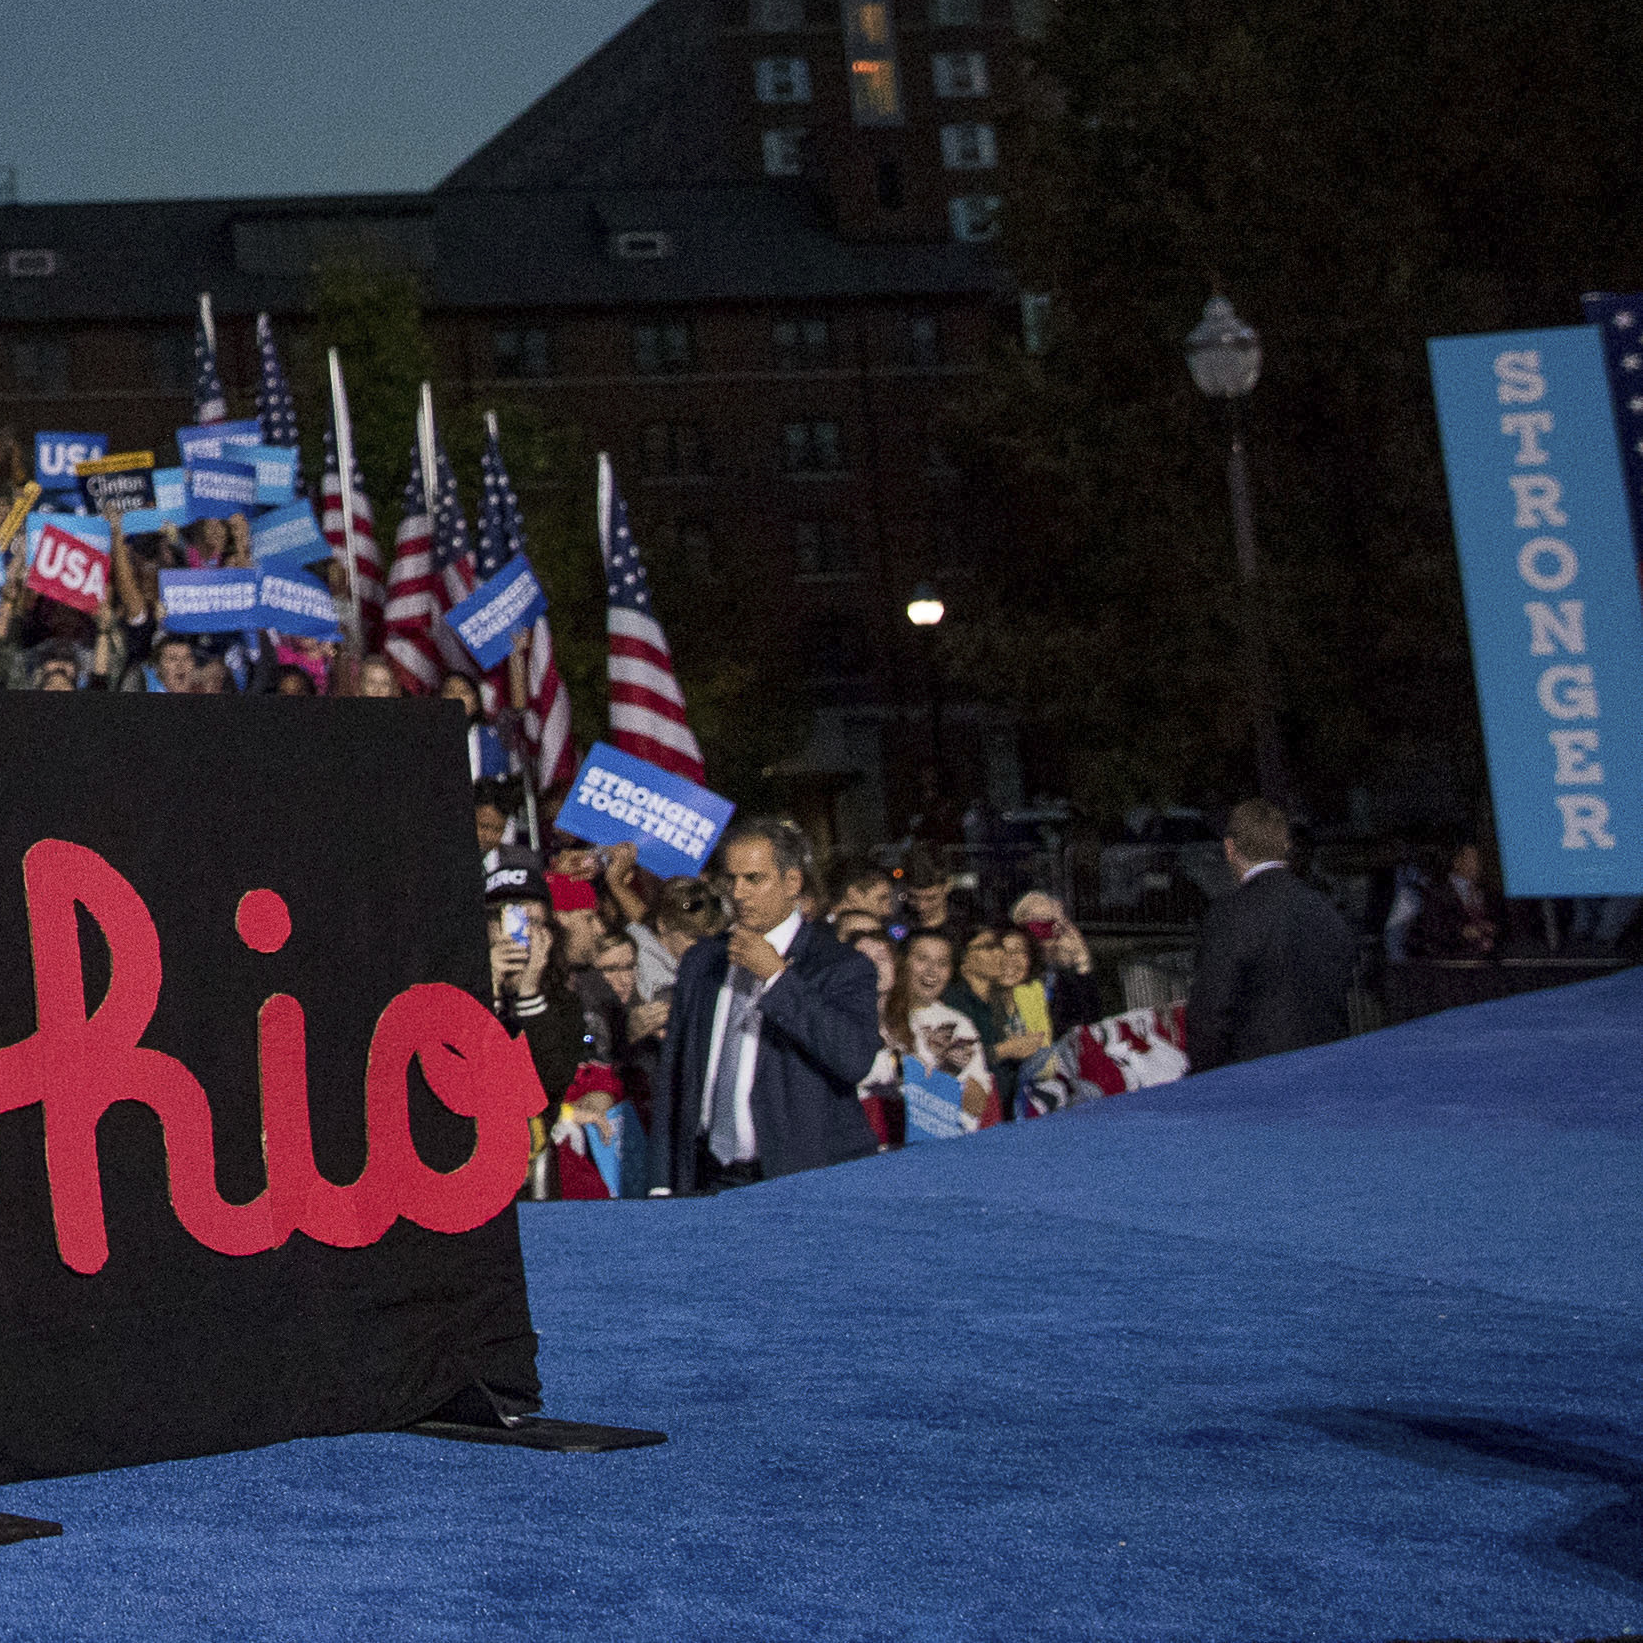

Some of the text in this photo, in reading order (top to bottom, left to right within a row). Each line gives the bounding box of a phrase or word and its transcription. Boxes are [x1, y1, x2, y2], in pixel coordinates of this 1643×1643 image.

[37, 537, 106, 601] USA
[1492, 349, 1615, 850] STRONGER
[577, 785, 706, 860] TOGETHER
[584, 766, 716, 838] STRONGER
